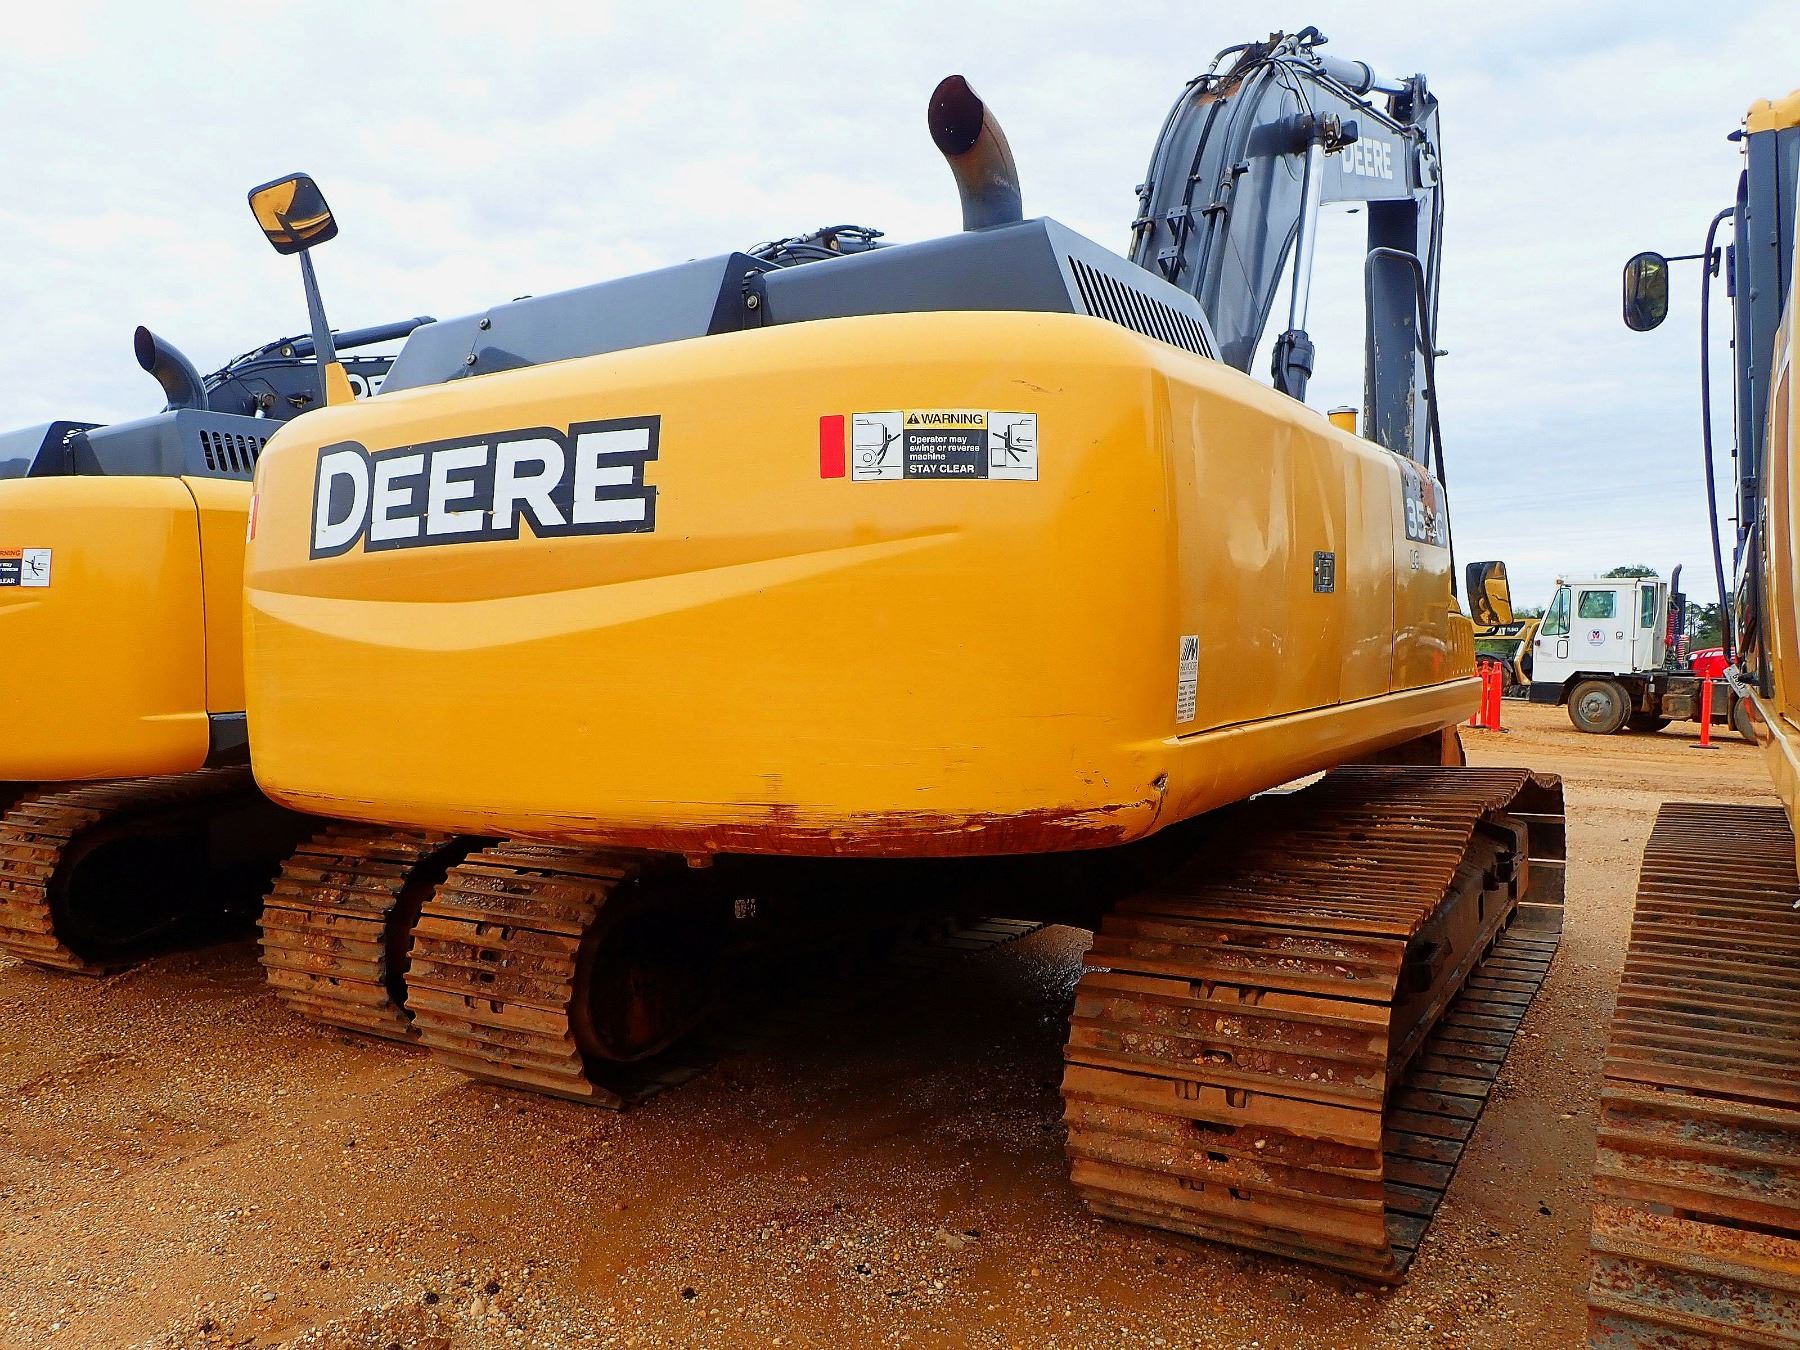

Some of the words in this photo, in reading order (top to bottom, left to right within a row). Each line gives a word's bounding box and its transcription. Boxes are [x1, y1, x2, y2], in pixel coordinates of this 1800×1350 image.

[1342, 137, 1392, 179] DEERE
[921, 413, 983, 424] WARNING
[909, 435, 947, 444] Operator
[949, 436, 967, 444] may
[909, 445, 935, 453] swing
[909, 453, 946, 461] machine
[909, 464, 937, 474] STAY
[940, 464, 975, 474] CLEAR
[314, 427, 650, 550] DEERE
[1406, 497, 1445, 545] 35G
